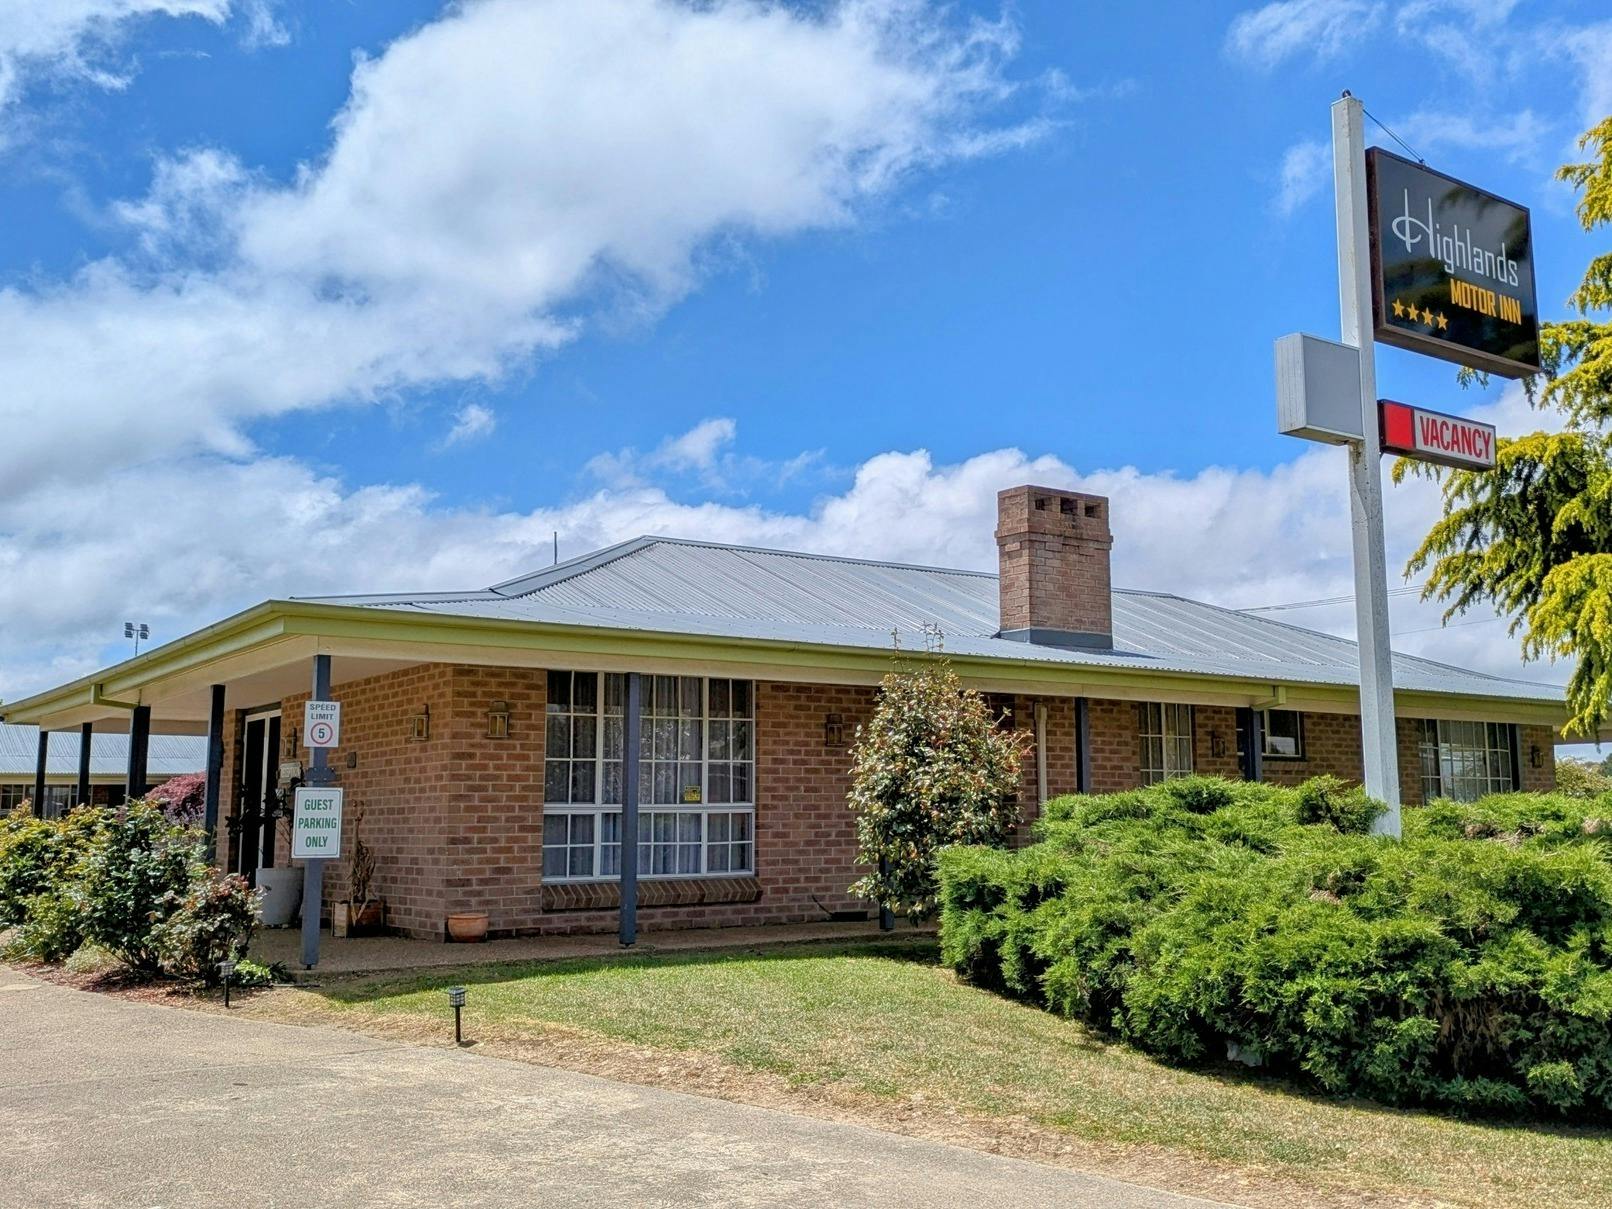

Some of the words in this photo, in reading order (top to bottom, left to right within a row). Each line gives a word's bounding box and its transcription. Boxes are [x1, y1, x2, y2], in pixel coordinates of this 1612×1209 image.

[1391, 188, 1519, 287] Highlands
[1450, 278, 1496, 317] MOTOR
[1499, 294, 1522, 326] INN
[1419, 416, 1491, 460] VACANCY
[309, 703, 337, 711] SPEED
[310, 712, 334, 720] LIMIT
[318, 728, 325, 739] 5
[304, 799, 334, 811] GUEST
[298, 817, 337, 829] PARKING
[305, 836, 329, 848] ONLY
